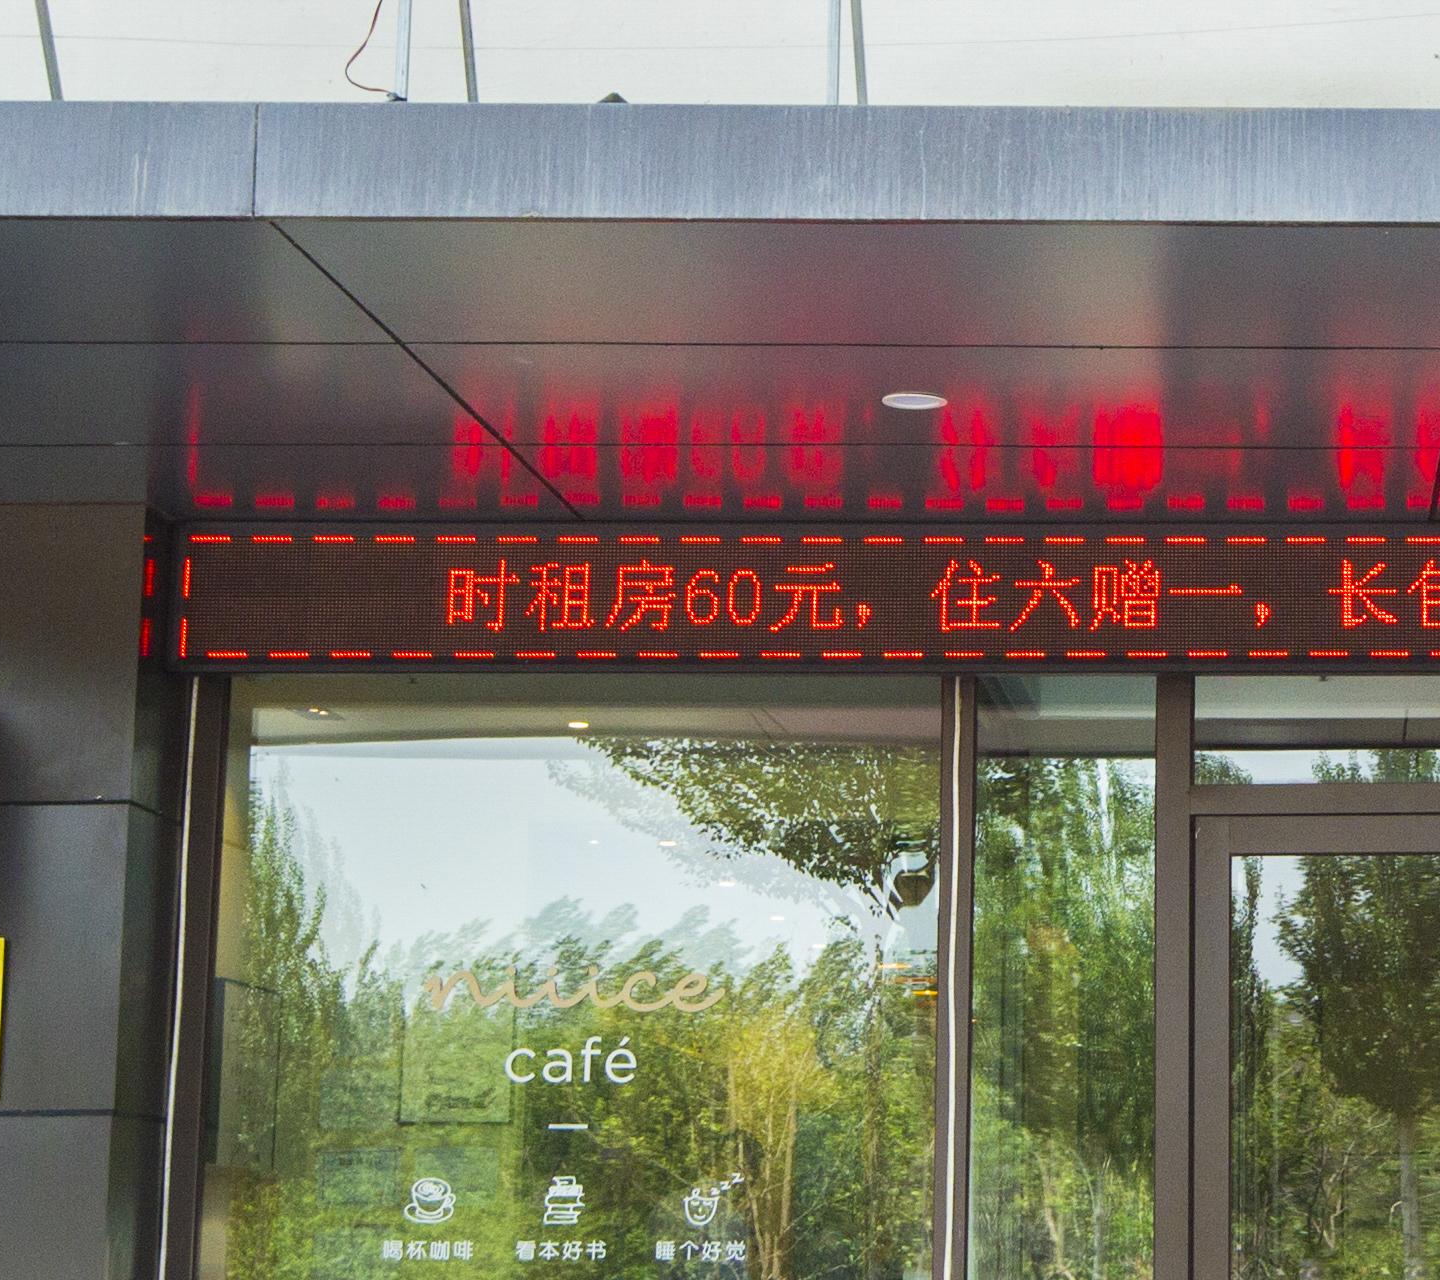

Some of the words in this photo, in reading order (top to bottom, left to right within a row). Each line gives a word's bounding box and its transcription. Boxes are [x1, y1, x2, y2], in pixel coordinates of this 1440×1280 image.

[424, 965, 726, 1013] niiice
[504, 1036, 638, 1084] café
[381, 1239, 474, 1262] 喝杯咖啡
[514, 1239, 607, 1262] 看本好书
[654, 1239, 747, 1262] 睡个好觉
